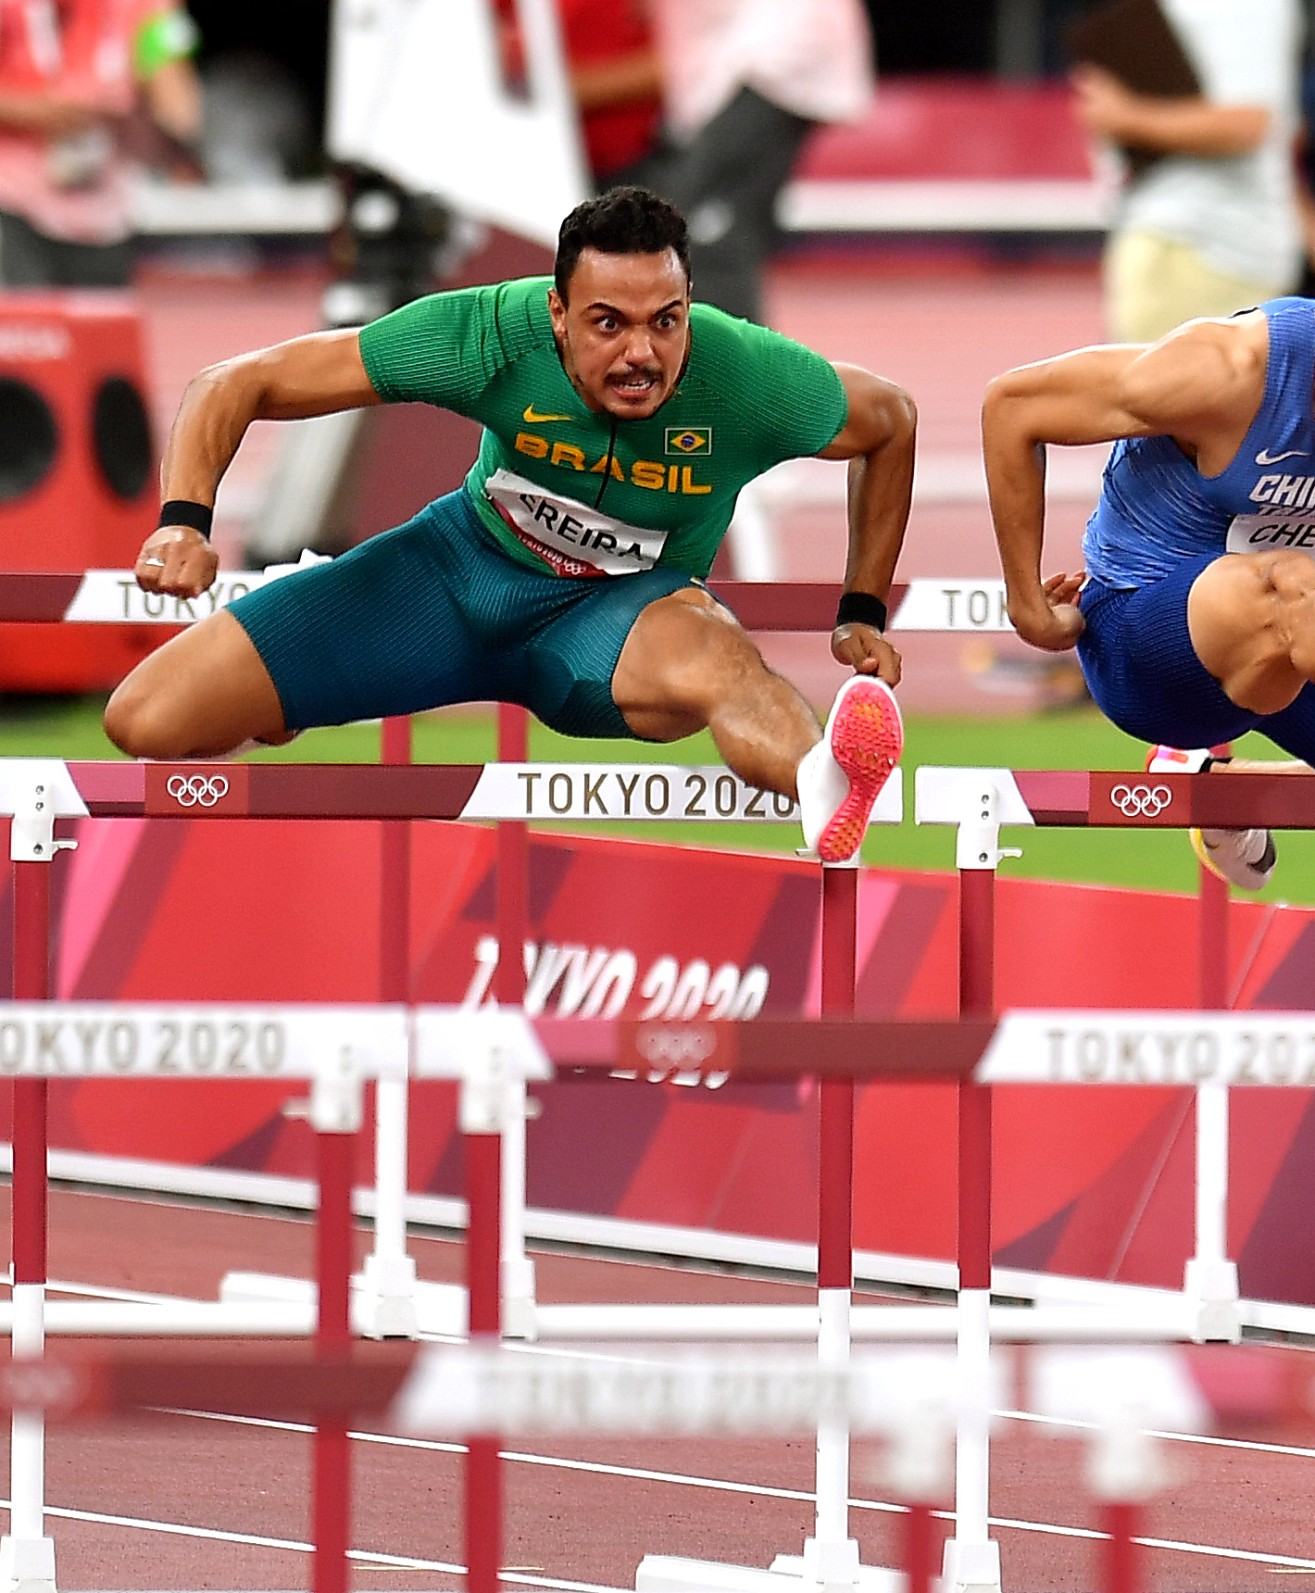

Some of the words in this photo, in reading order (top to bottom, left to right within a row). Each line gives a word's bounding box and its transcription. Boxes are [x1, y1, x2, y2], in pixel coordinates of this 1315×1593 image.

[515, 432, 712, 494] BRASIL
[517, 773, 670, 816] TOKYO
[0, 1021, 139, 1074] OKYO
[154, 1021, 286, 1073] 2020
[1046, 1028, 1220, 1083] TOKYO
